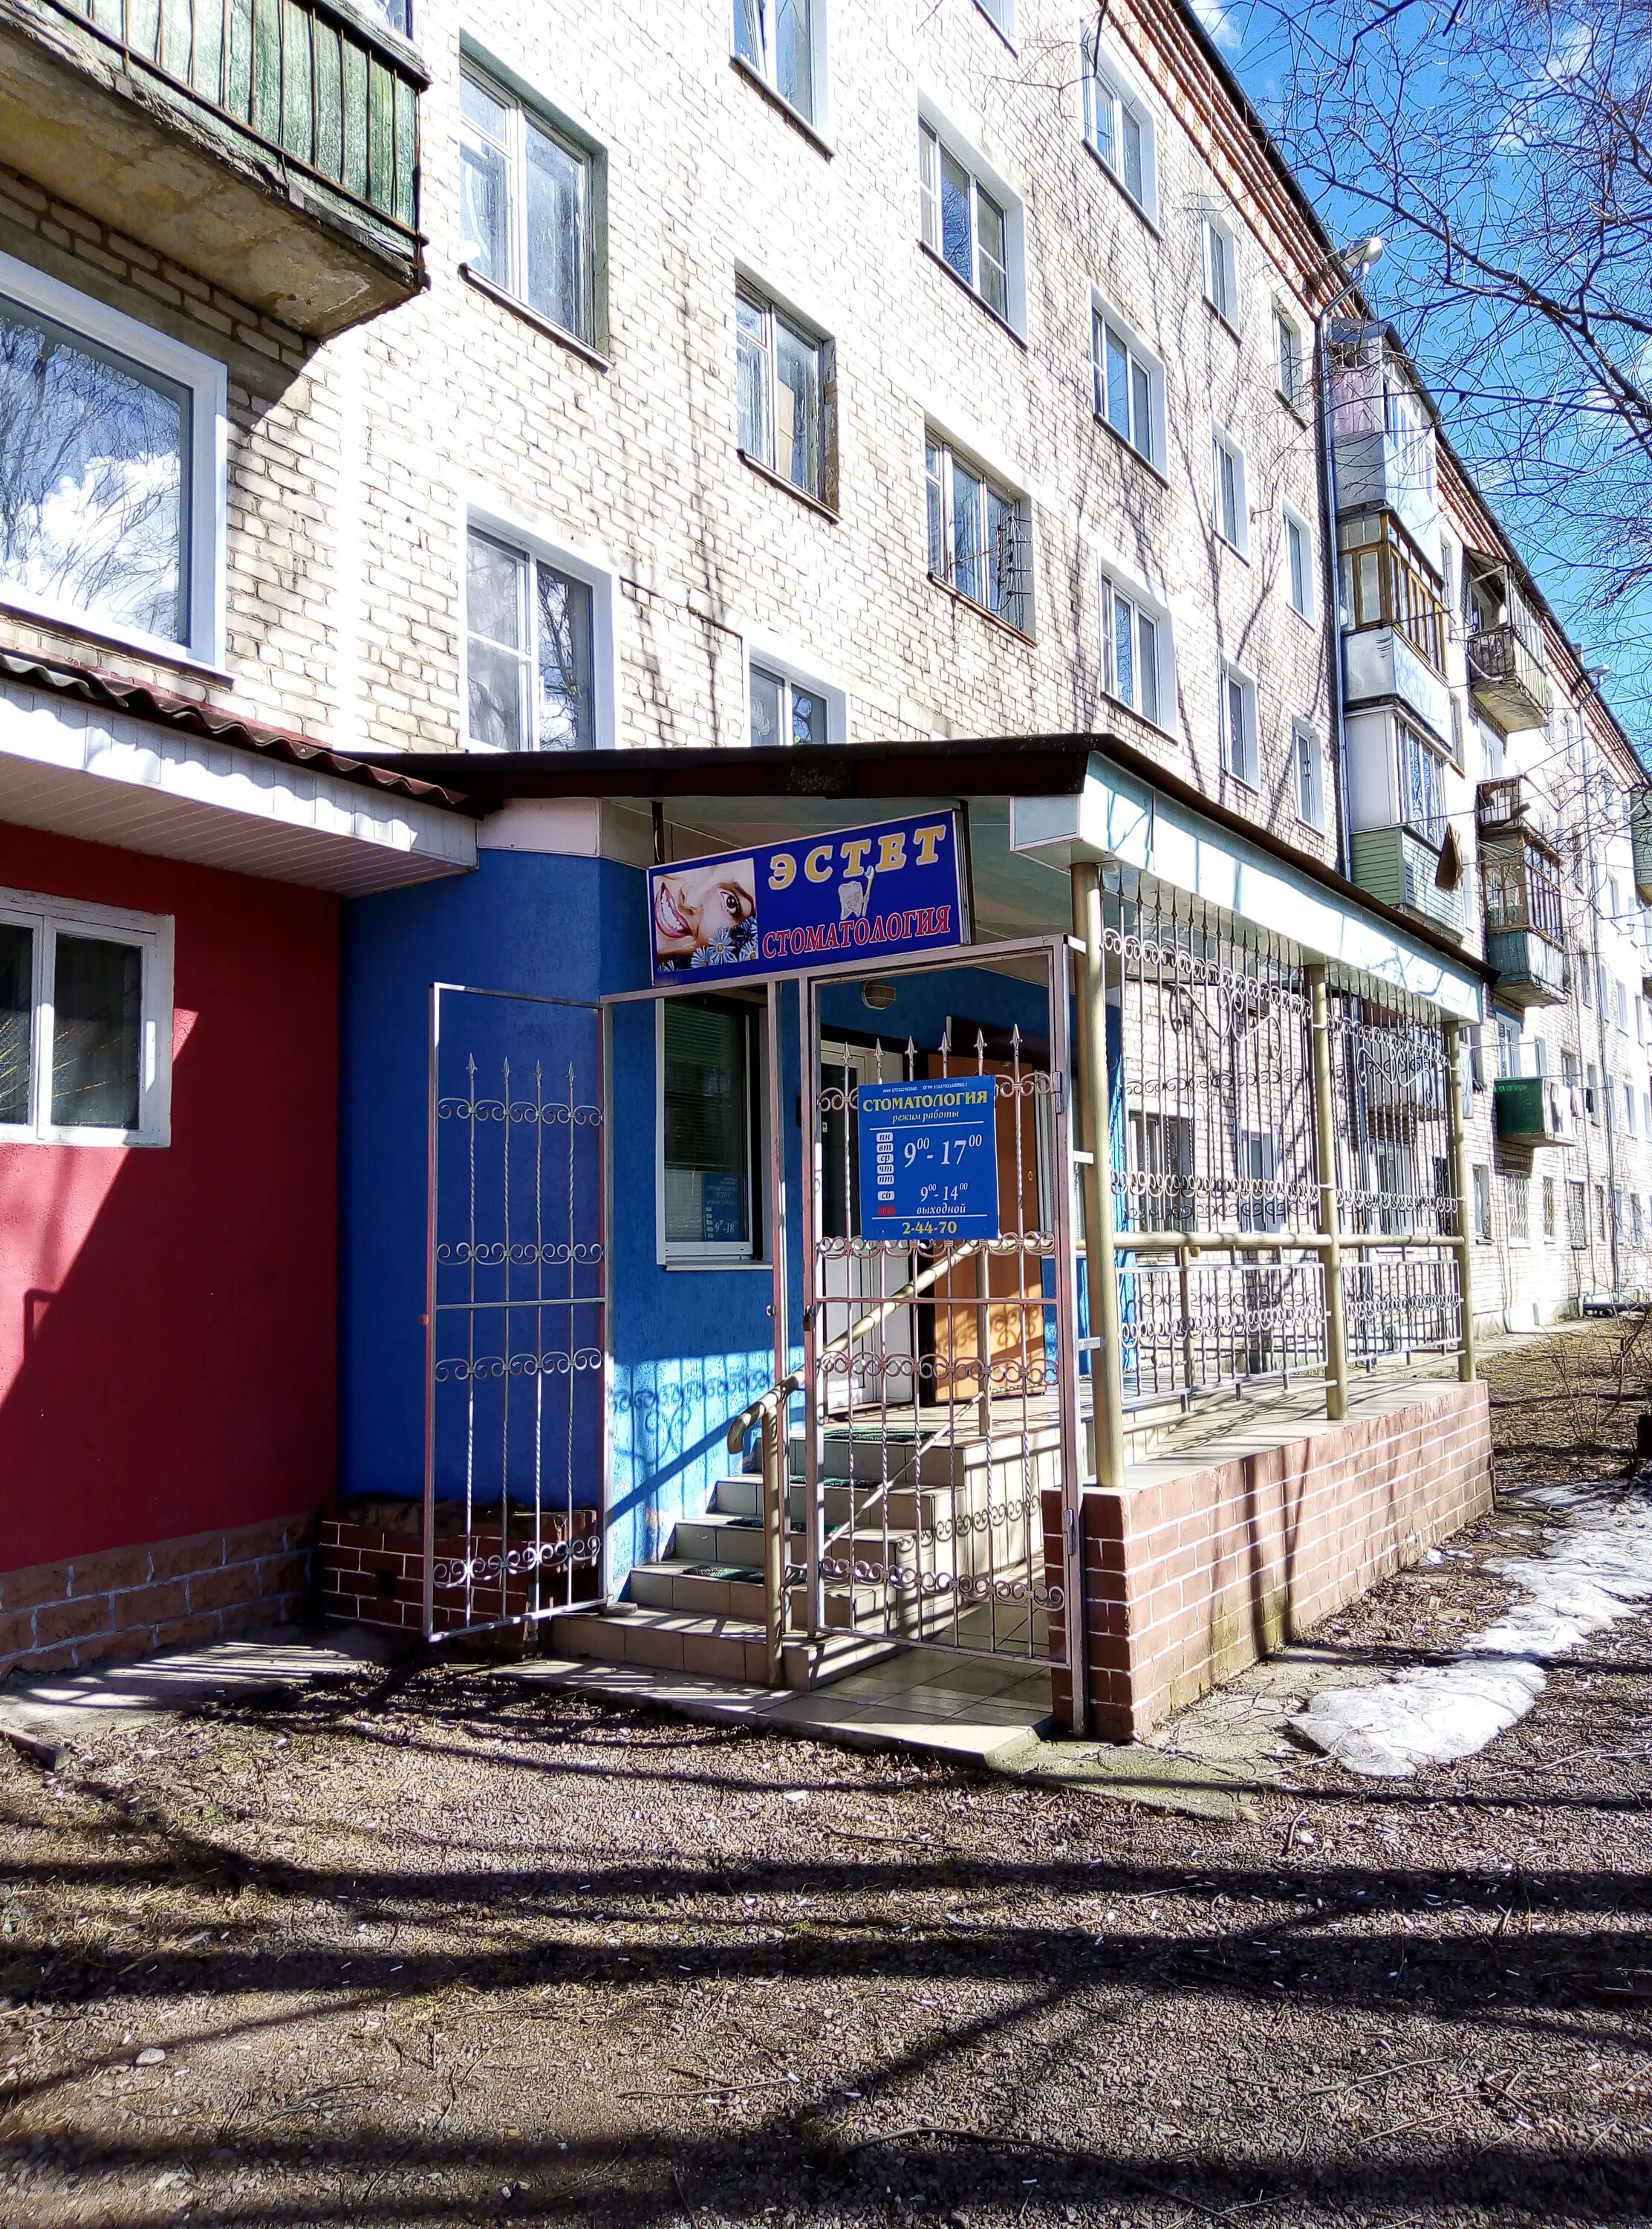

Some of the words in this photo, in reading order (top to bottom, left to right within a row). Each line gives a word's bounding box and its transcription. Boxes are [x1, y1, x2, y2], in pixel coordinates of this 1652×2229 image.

[768, 824, 946, 890] ЭСТЕТ
[762, 905, 952, 958] СТОМАТОЛОГИЯ
[862, 1091, 988, 1112] СТОМАТОЛОГИЯ
[892, 1112, 920, 1124] режим
[922, 1109, 960, 1123] работы
[880, 1155, 891, 1164] ср
[917, 1202, 966, 1215] выходной
[902, 1221, 957, 1234] 2-44-70
